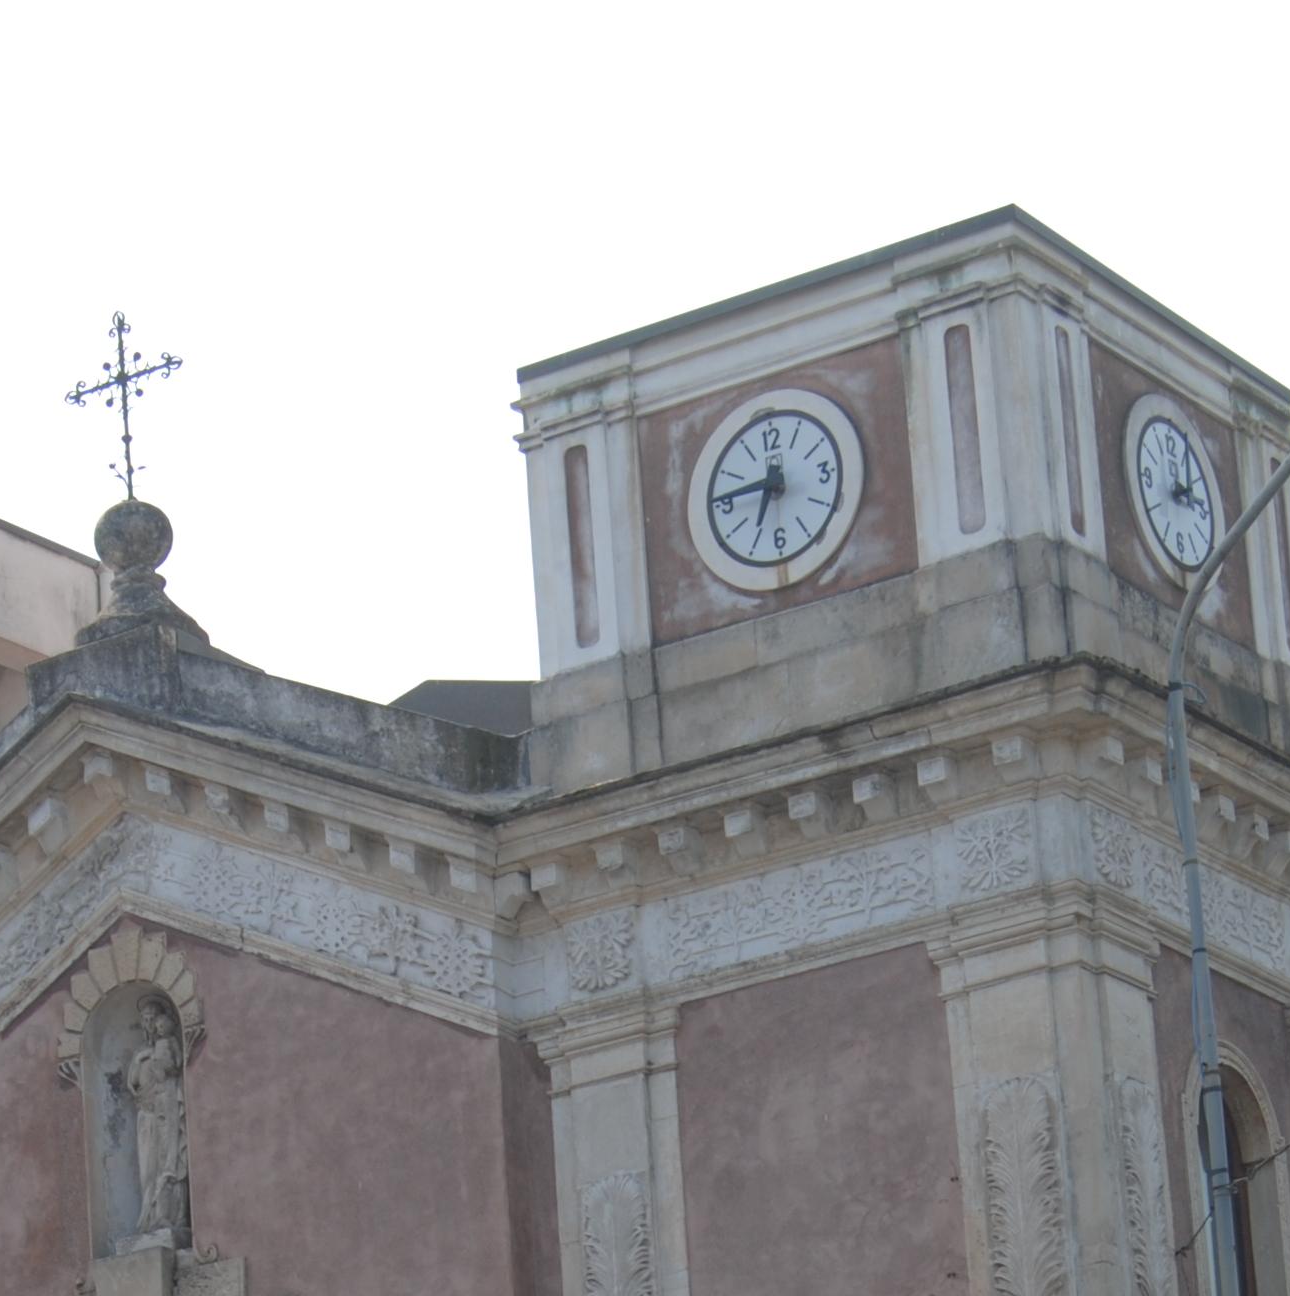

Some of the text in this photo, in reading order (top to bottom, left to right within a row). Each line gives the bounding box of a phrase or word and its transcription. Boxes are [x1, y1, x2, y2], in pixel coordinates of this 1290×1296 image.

[762, 428, 782, 452] 12
[816, 460, 831, 484] 3
[773, 527, 787, 549] 6
[1176, 531, 1185, 554] 6
